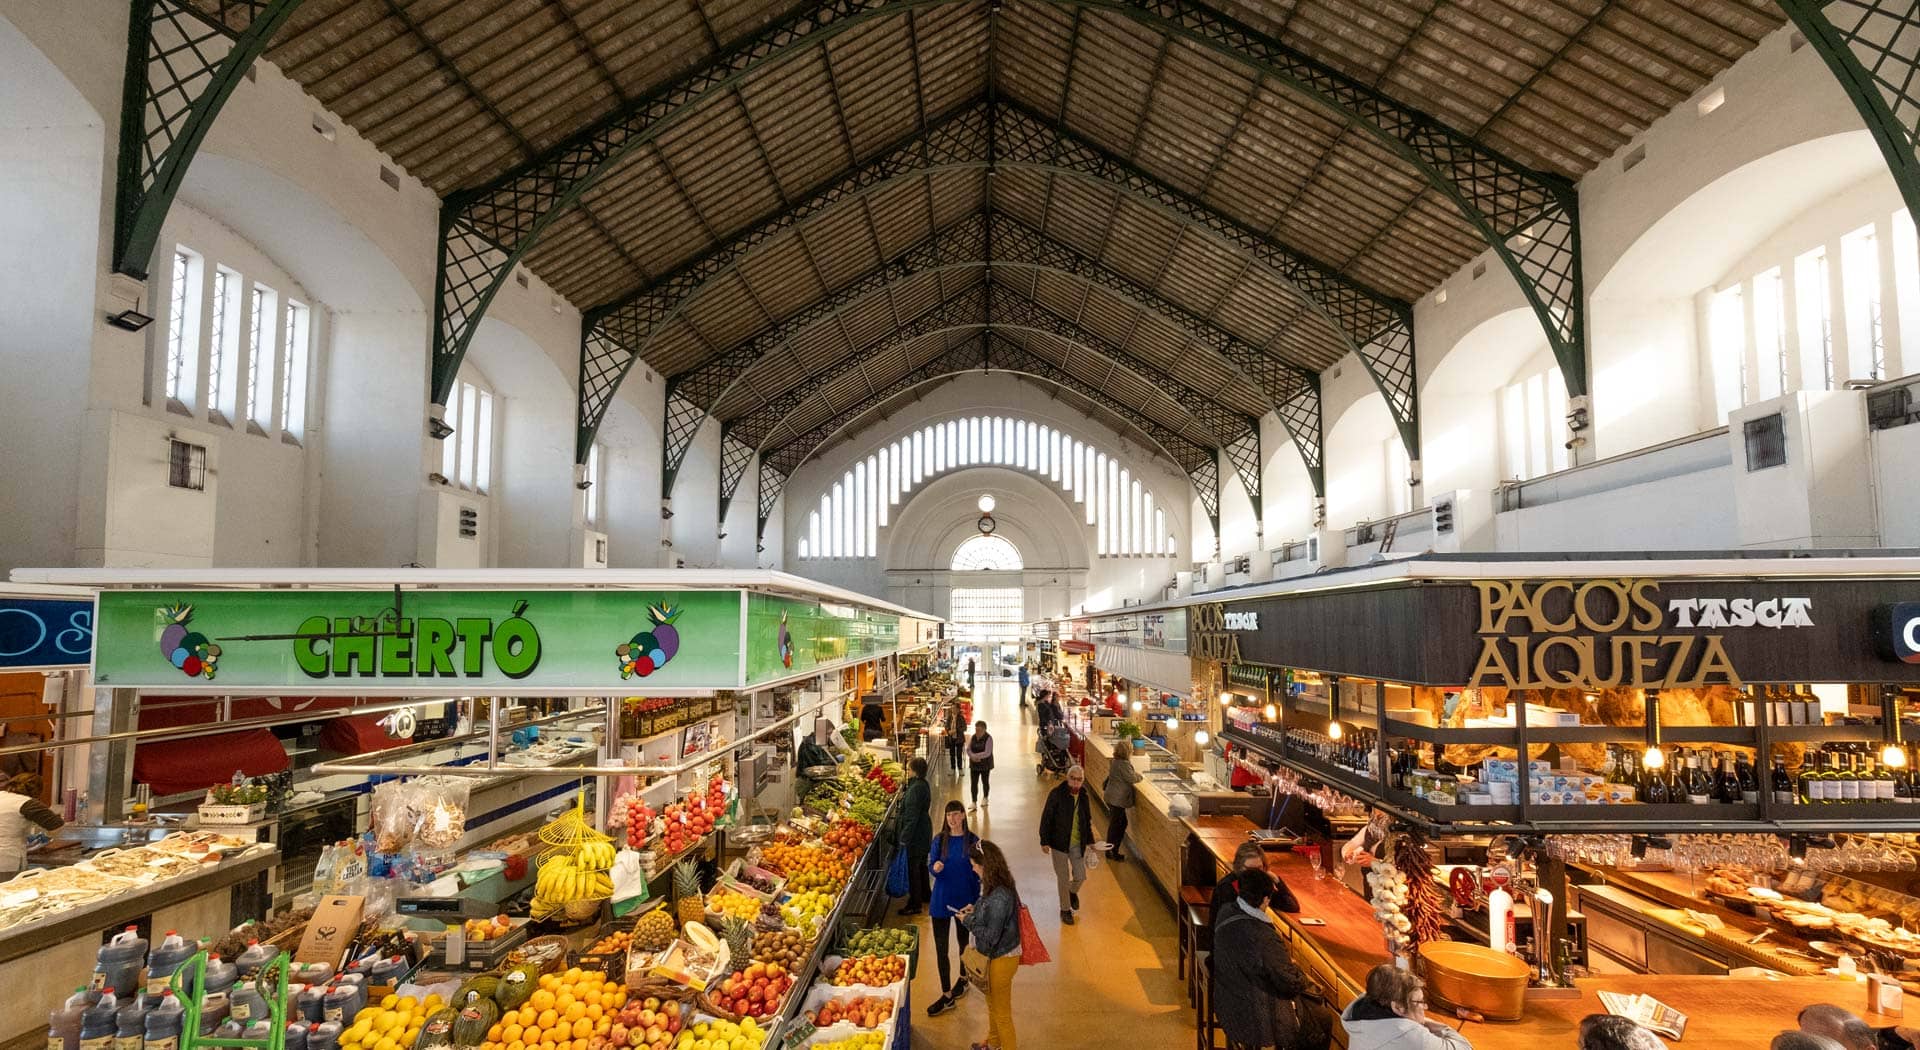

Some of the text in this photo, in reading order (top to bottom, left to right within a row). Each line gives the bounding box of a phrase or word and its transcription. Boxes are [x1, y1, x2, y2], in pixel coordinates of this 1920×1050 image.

[1471, 578, 1815, 633] PACO'S TASCA
[294, 600, 542, 679] CHERTÓ
[1466, 635, 1746, 691] ALQUEZA
